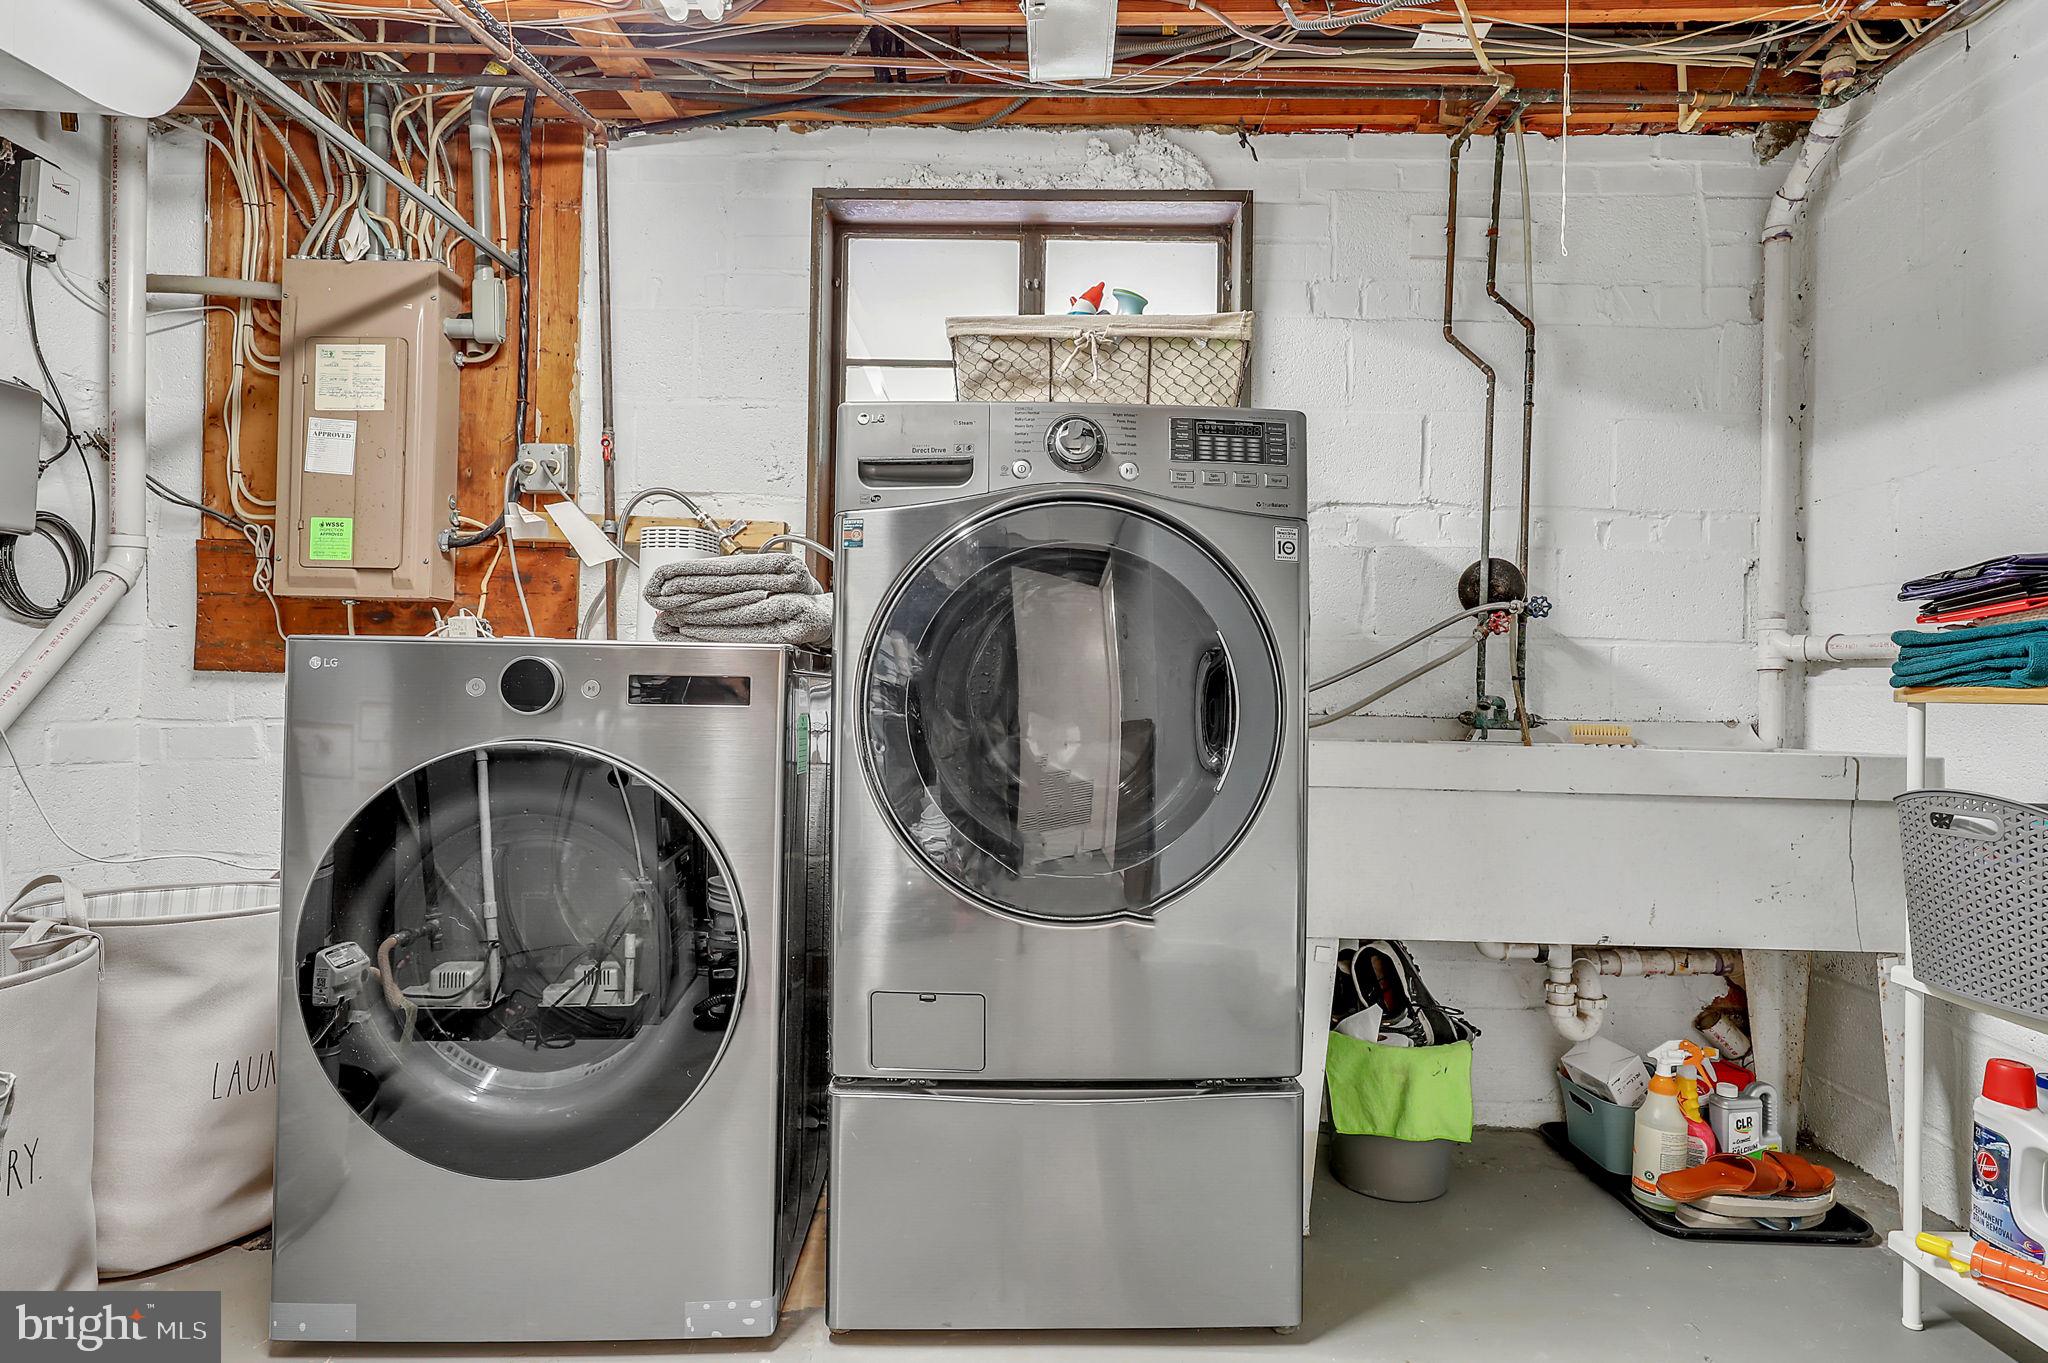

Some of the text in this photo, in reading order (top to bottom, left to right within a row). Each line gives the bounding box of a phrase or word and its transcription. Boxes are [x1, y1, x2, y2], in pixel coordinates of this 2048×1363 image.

[52, 184, 70, 195] verizon
[313, 430, 352, 439] APPROVED
[1735, 1115, 1754, 1130] CLR
[1975, 1178, 1999, 1195] OXY
[1972, 1203, 2004, 1227] PERMANENT
[1985, 1219, 2015, 1242] REMOVAL
